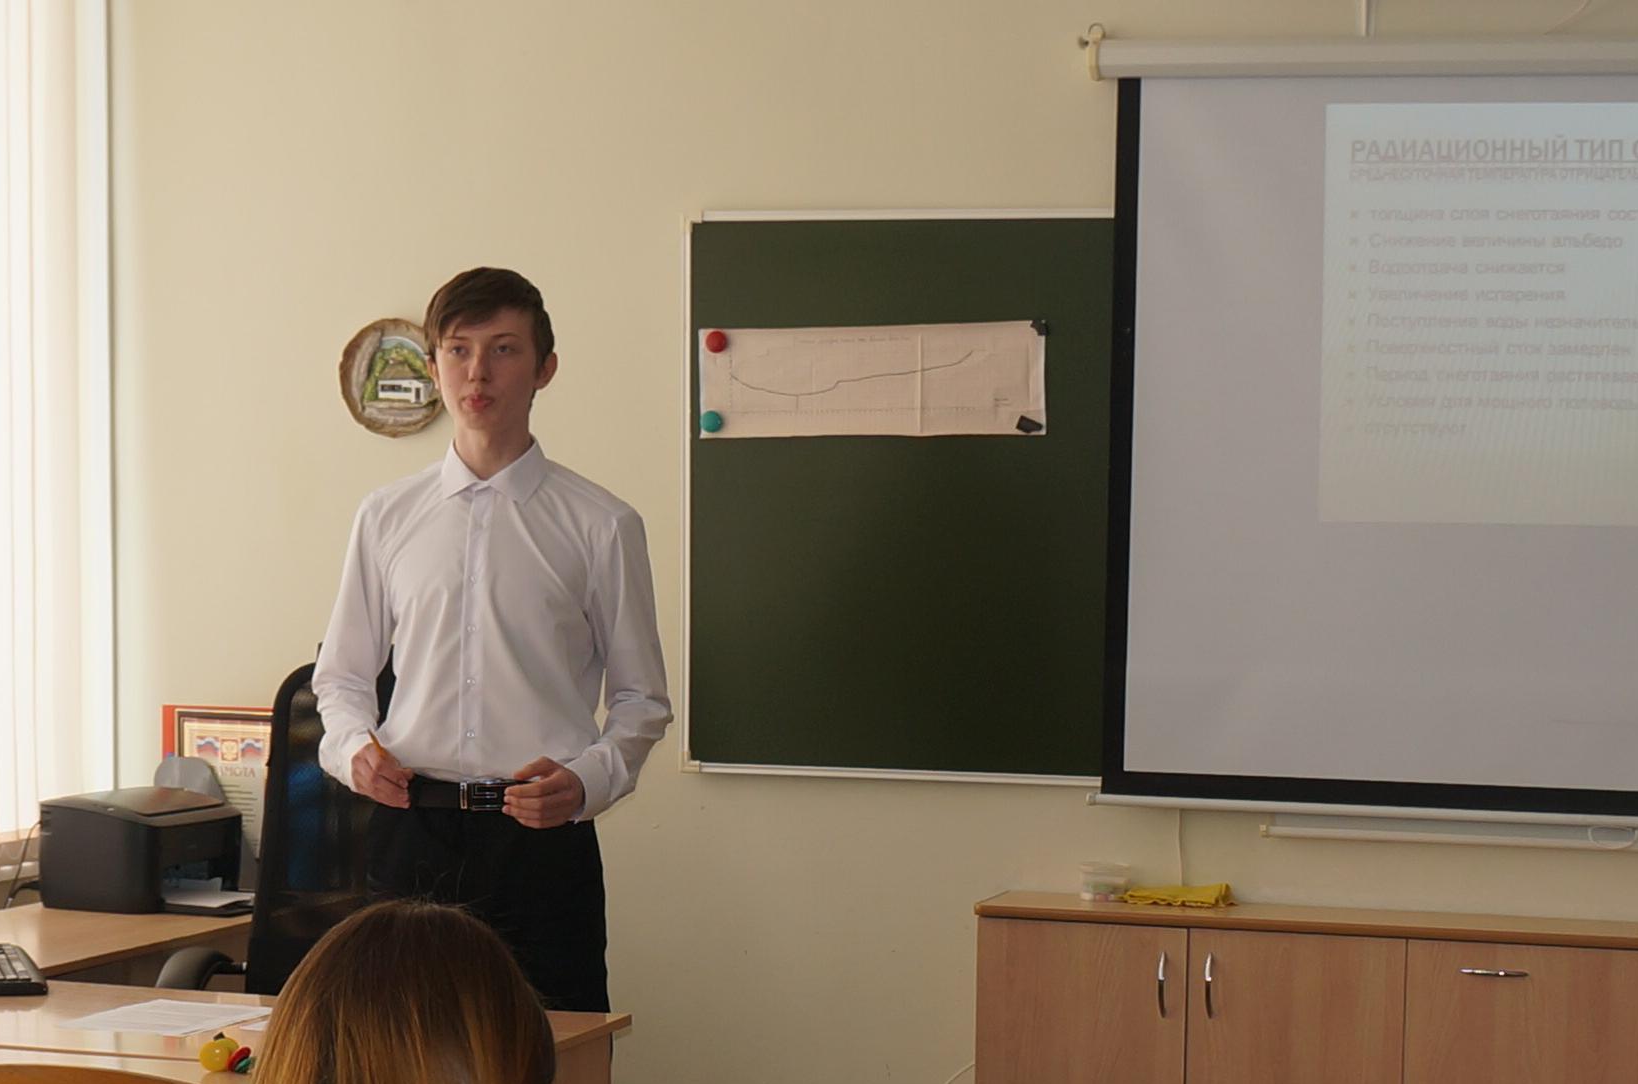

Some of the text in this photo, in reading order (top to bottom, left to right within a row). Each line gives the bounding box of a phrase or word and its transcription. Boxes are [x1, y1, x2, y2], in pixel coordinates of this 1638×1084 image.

[1351, 134, 1568, 163] РАДИАЦИОННЫЙ
[1575, 140, 1624, 162] ТИП
[1370, 207, 1445, 224] толщина
[1451, 207, 1490, 221] слоя
[1496, 207, 1600, 221] снеготаяния
[1369, 233, 1456, 248] Снижение
[1551, 233, 1623, 250] альбедо
